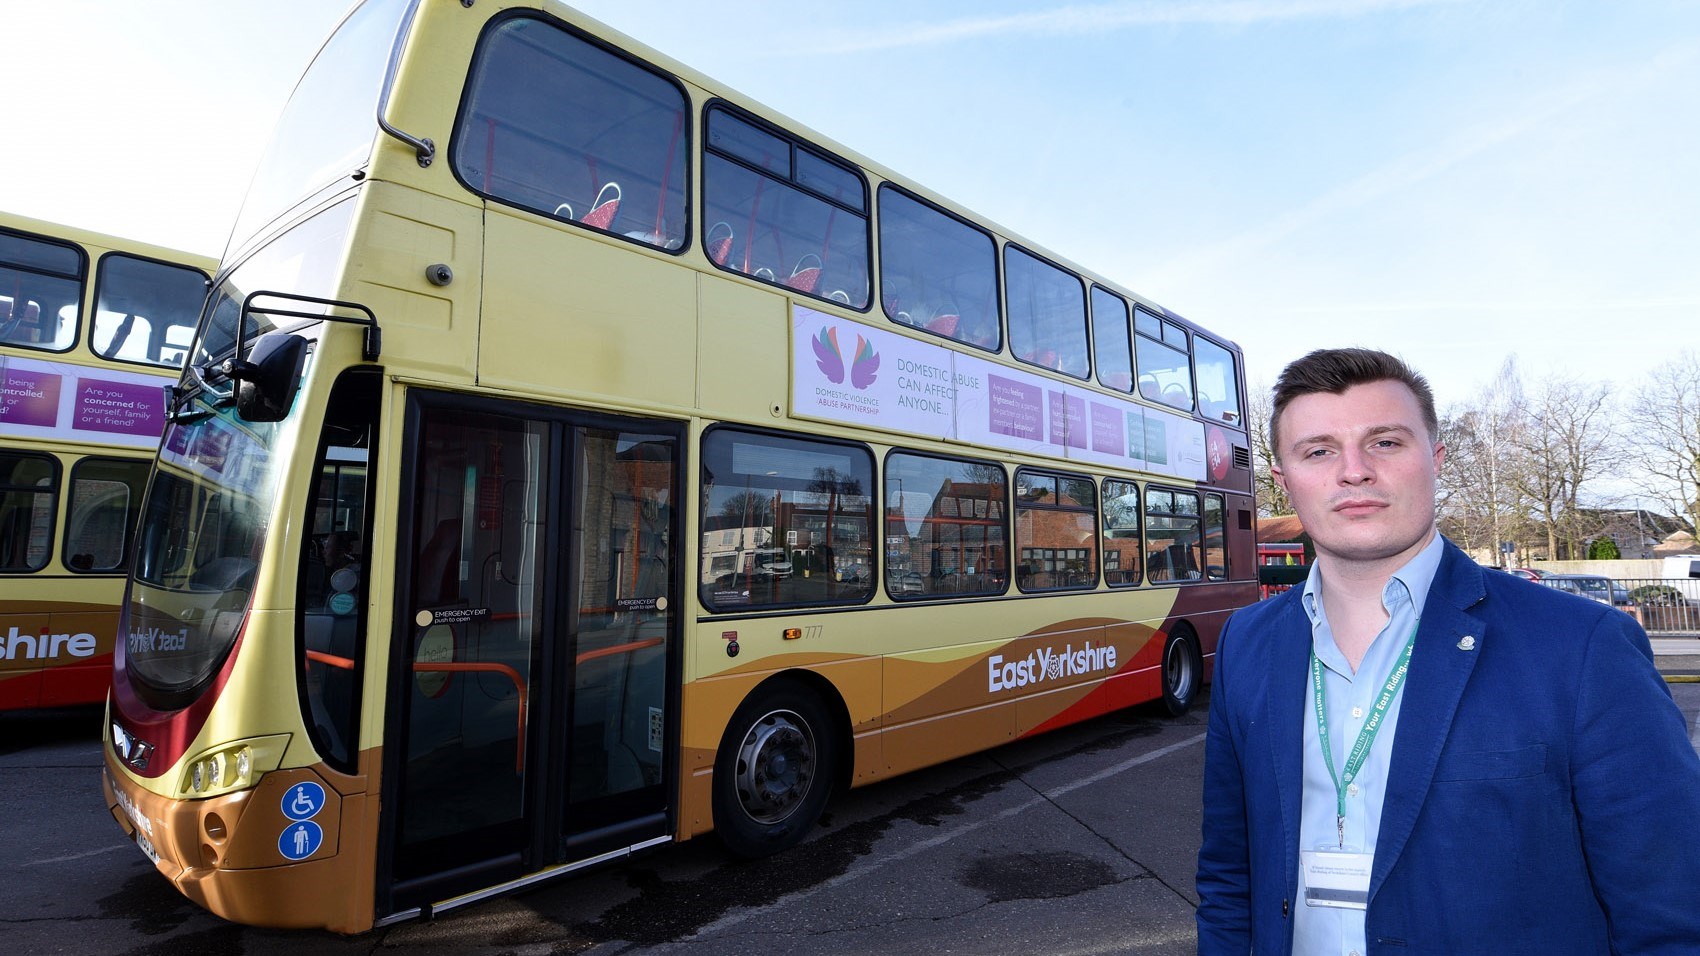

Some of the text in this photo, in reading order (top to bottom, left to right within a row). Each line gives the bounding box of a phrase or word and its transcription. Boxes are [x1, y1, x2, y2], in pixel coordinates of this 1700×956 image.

[897, 358, 980, 390] DOMESTIC ABUSE
[8, 377, 35, 389] being
[897, 376, 960, 401] CAN AFFECT
[0, 388, 45, 399] ontrolled,
[85, 387, 124, 399] Are you
[815, 387, 880, 407] DOMESTIC VIOLENCE
[7, 398, 19, 406] or
[84, 397, 150, 410] concerned for
[818, 398, 880, 416] ABUSE PARTNERSHIP
[897, 395, 949, 416] ANYONE...
[82, 406, 151, 421] yourself, family
[104, 415, 136, 427] friend?
[434, 609, 474, 618] EMERGENCY
[804, 624, 824, 640] 777
[0, 626, 97, 661] hire
[988, 640, 1117, 693] East Yorkshire
[1313, 654, 1325, 724] veryone matters
[1365, 712, 1380, 732] Your
[1376, 692, 1391, 711] East
